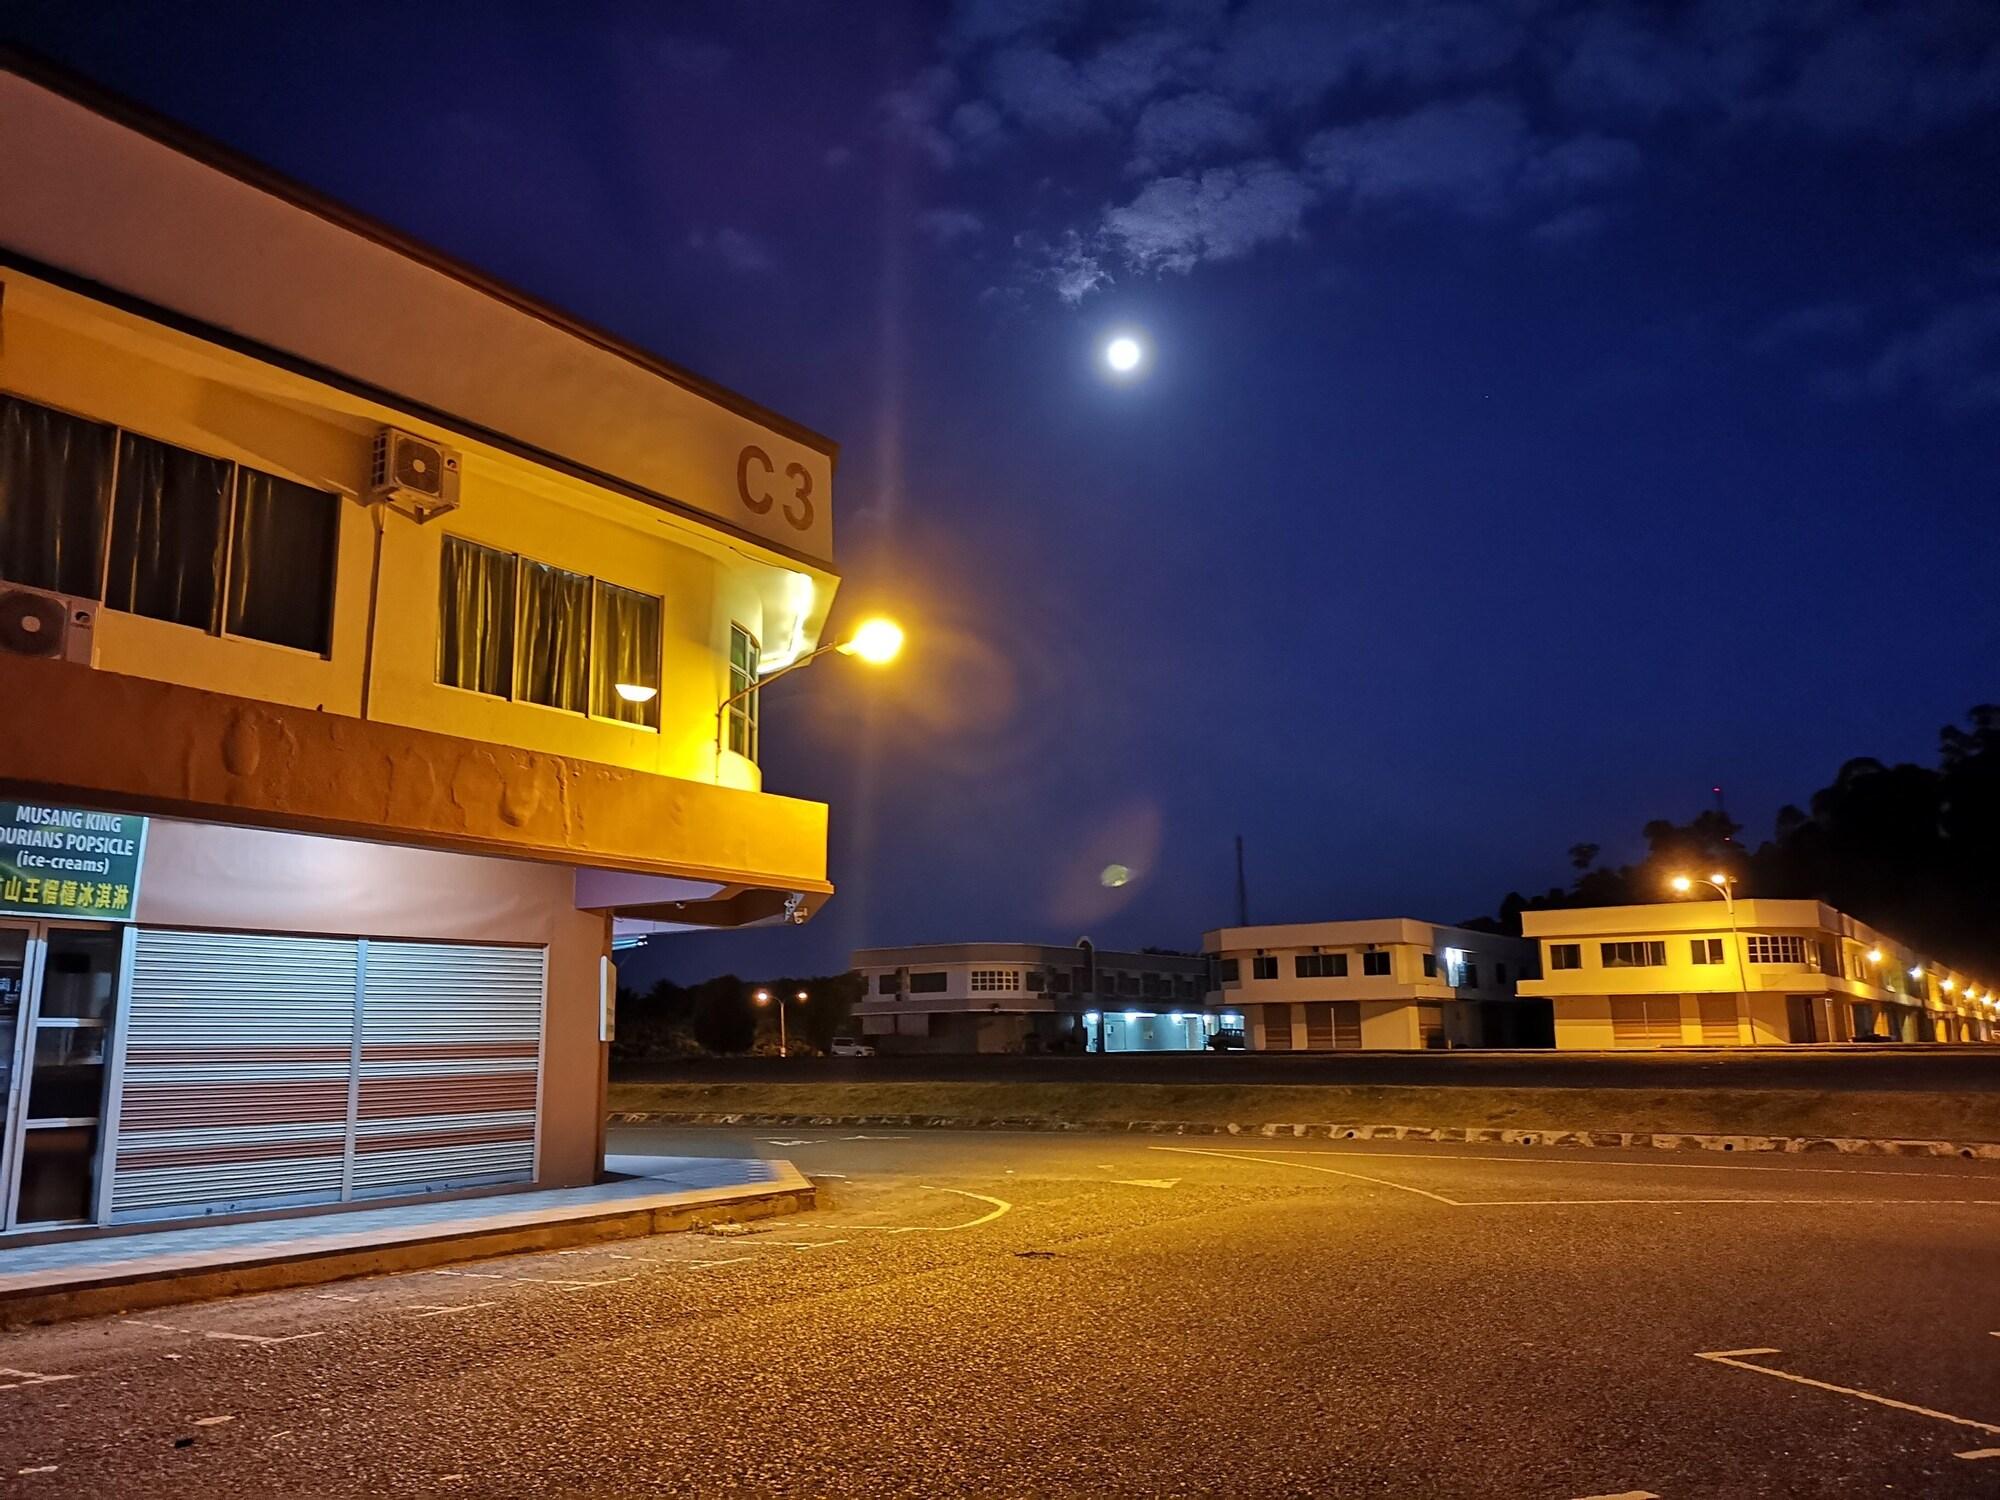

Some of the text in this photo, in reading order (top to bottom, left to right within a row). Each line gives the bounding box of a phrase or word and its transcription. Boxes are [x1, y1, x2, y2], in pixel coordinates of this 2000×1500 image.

[737, 445, 814, 531] C3
[16, 805, 122, 833] MUSANG KING
[66, 834, 135, 856] POPSICLE
[16, 850, 110, 875] (ice-creams)
[0, 875, 129, 910] 山王榴槤冰淇淋
